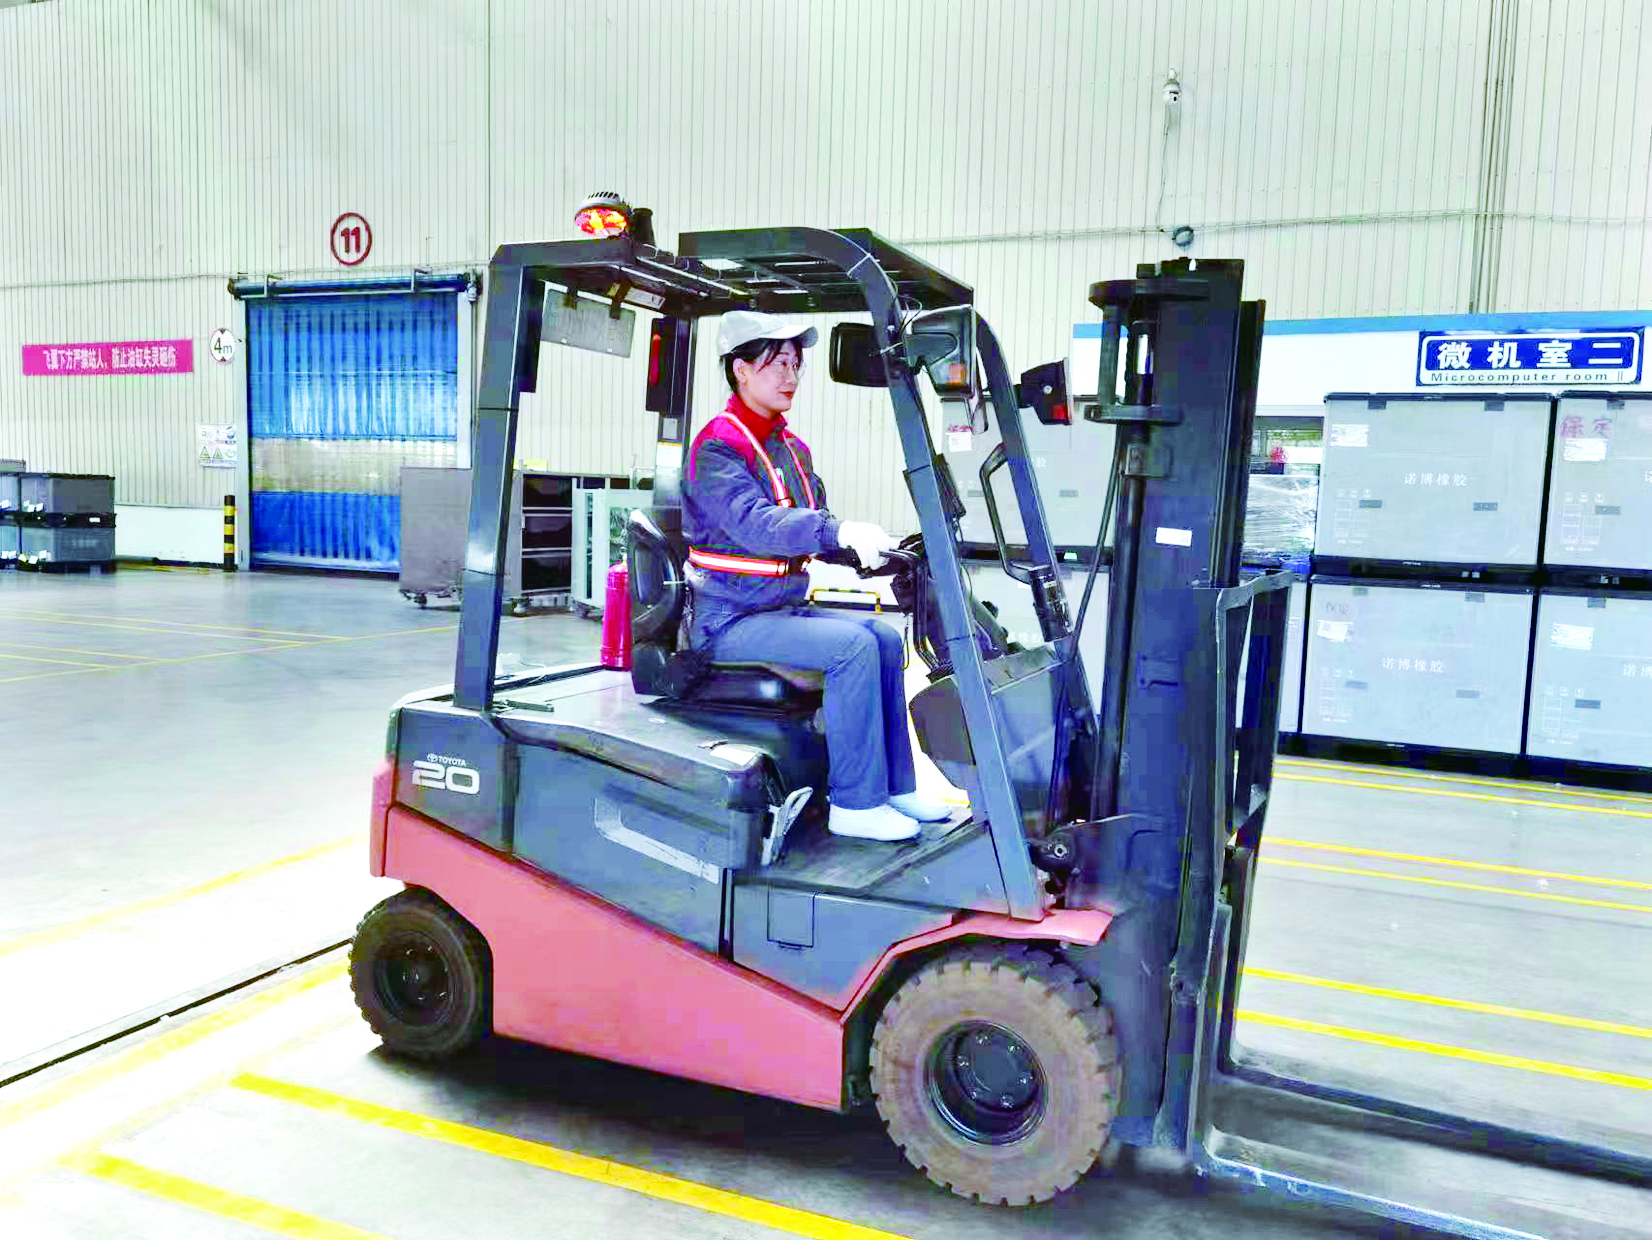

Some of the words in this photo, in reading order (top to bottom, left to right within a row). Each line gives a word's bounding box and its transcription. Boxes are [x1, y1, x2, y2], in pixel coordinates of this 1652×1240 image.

[341, 227, 360, 253] 11
[214, 337, 232, 353] 4m
[1437, 340, 1623, 369] 微机室二
[1431, 372, 1556, 384] Microcomputer
[1565, 373, 1608, 381] room
[438, 755, 466, 767] TOYOTA
[412, 760, 480, 794] 20
